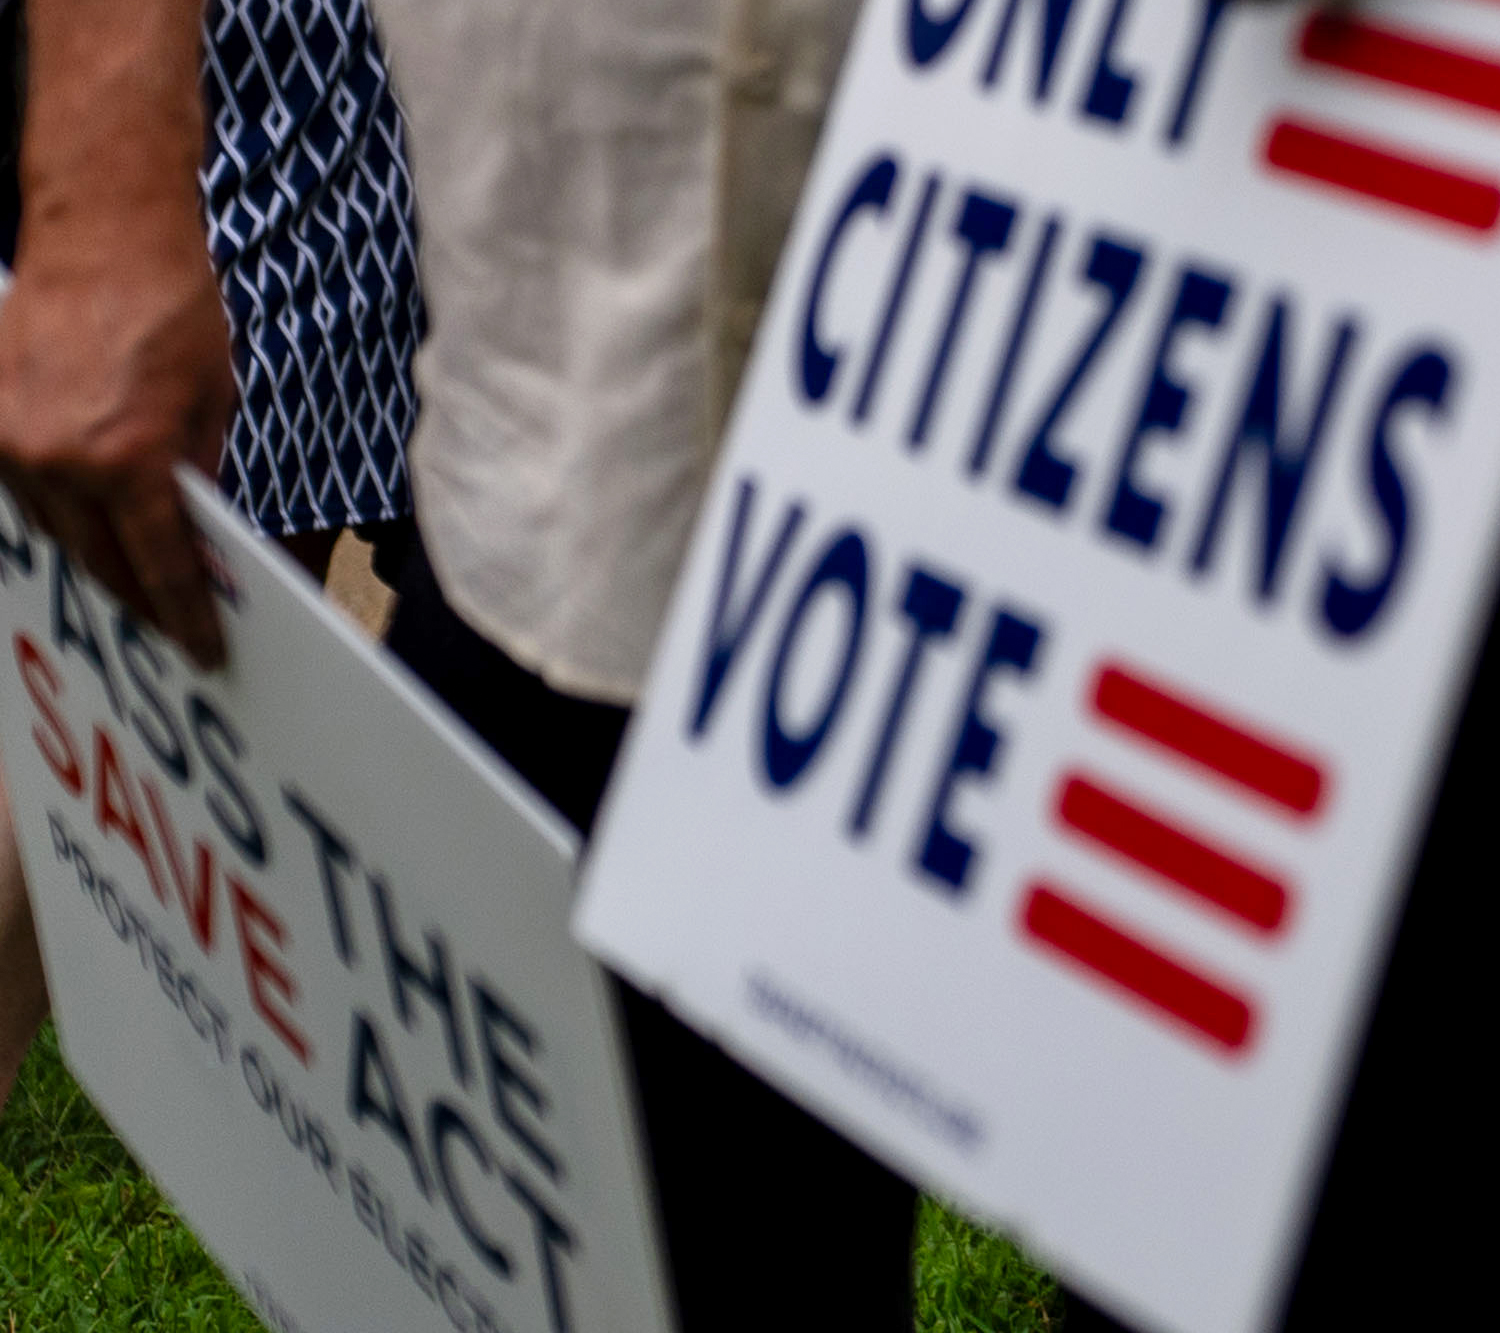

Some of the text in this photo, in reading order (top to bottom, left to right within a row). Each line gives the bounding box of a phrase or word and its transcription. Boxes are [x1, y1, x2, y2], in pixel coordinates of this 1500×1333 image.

[787, 145, 1465, 655] CITIZENS
[682, 473, 1050, 902] VOTE
[12, 630, 584, 1333] SAVE ACT
[44, 807, 234, 1064] PROTECT
[239, 1043, 342, 1197] OUR
[278, 778, 568, 1183] THE
